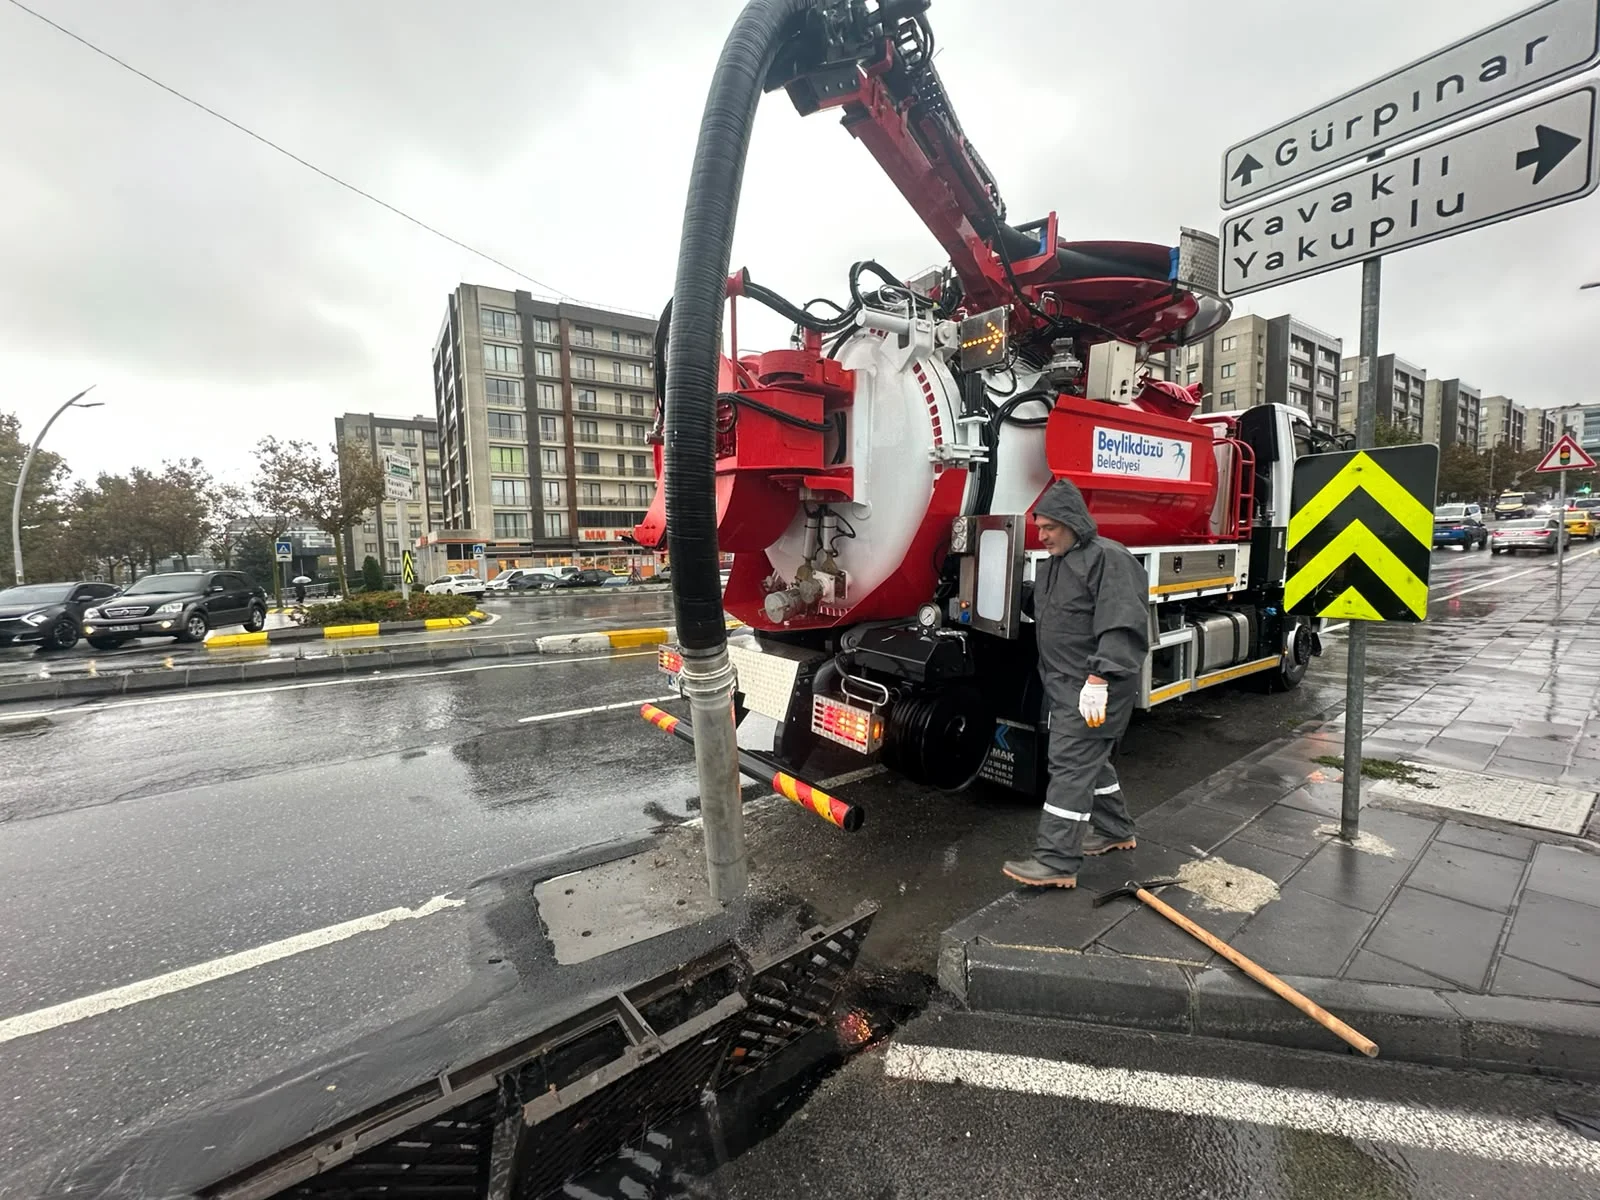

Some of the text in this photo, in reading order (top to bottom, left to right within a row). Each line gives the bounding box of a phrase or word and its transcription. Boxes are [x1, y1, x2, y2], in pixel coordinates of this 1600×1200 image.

[1275, 36, 1548, 167] Gürpınar
[1233, 155, 1449, 247] Kavaklı
[1233, 192, 1465, 278] Yakuplu
[1097, 454, 1141, 474] Belediyesi
[1098, 431, 1164, 458] Beylikdüzü
